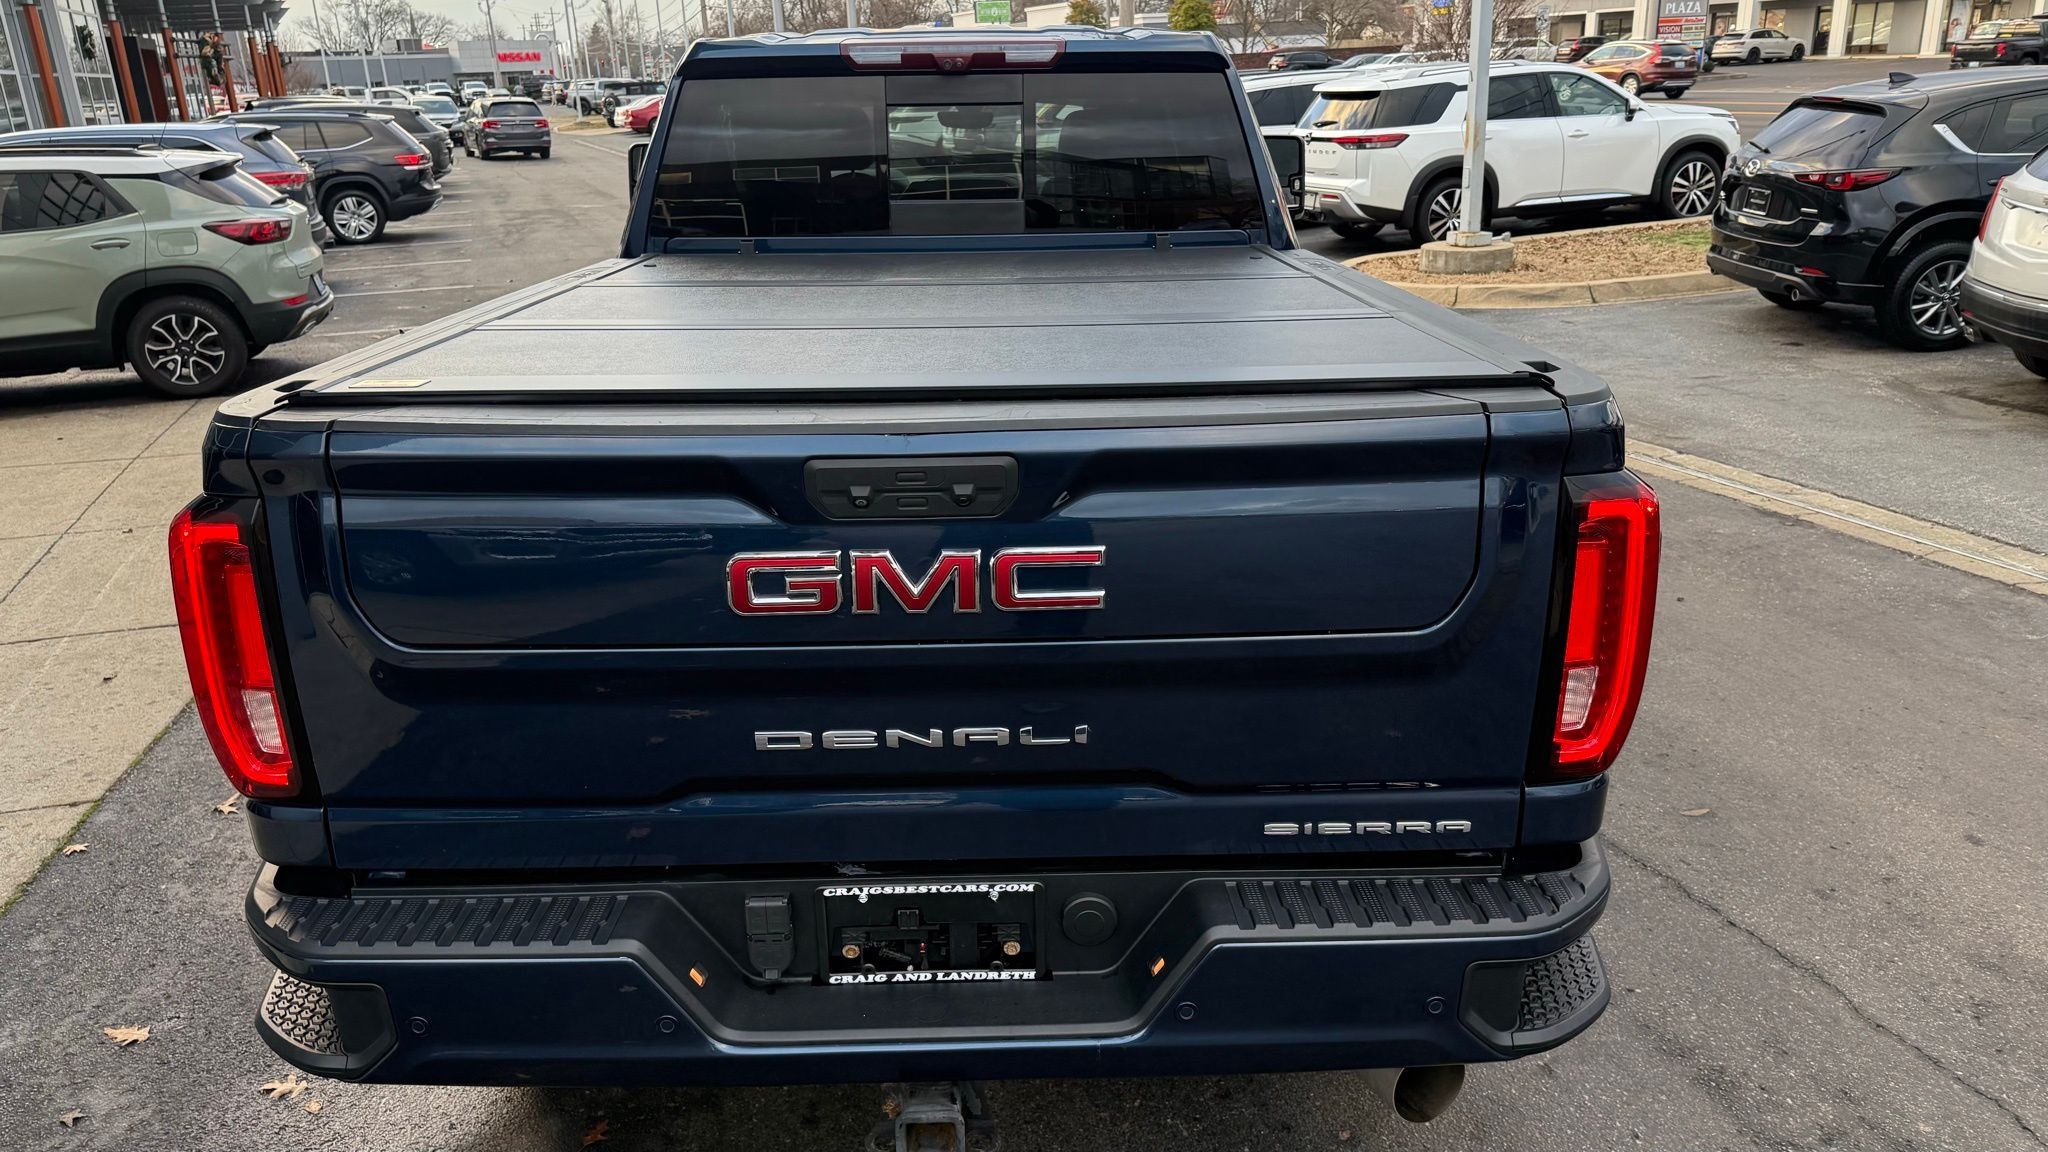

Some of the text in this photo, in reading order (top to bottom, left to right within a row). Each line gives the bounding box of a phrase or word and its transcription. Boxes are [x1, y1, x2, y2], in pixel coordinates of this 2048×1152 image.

[1665, 2, 1701, 14] PLAZA
[497, 52, 541, 62] NISSAN
[726, 546, 1107, 616] GMC
[754, 725, 1090, 752] DENALI
[1264, 820, 1472, 836] SIERRA
[823, 884, 1034, 896] CRAIGSBESTCARS.COM
[829, 971, 1036, 984] CRAIG AND LANDRETH
